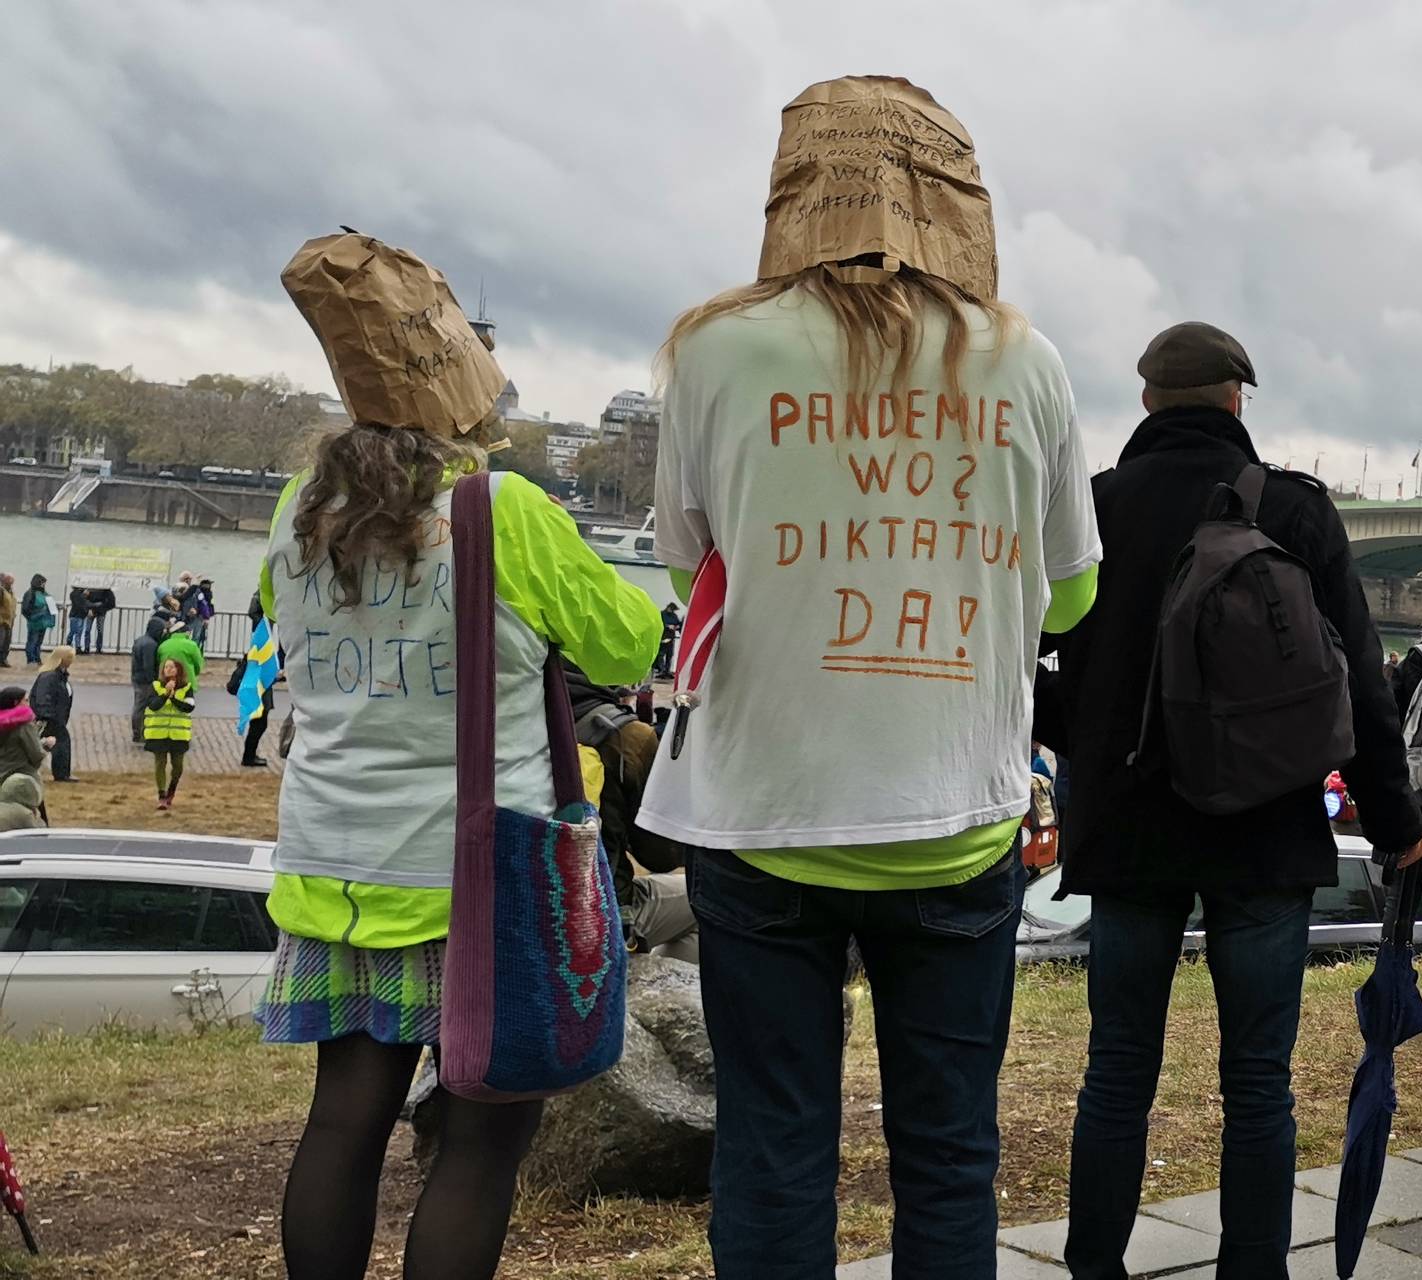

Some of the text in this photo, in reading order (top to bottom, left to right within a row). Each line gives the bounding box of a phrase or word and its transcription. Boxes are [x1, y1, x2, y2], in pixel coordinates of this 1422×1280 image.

[770, 389, 1013, 447] PANDEMIE
[849, 451, 977, 511] WO?
[302, 555, 450, 613] KDER
[826, 587, 978, 659] DA!
[305, 627, 456, 699] FOLTE
